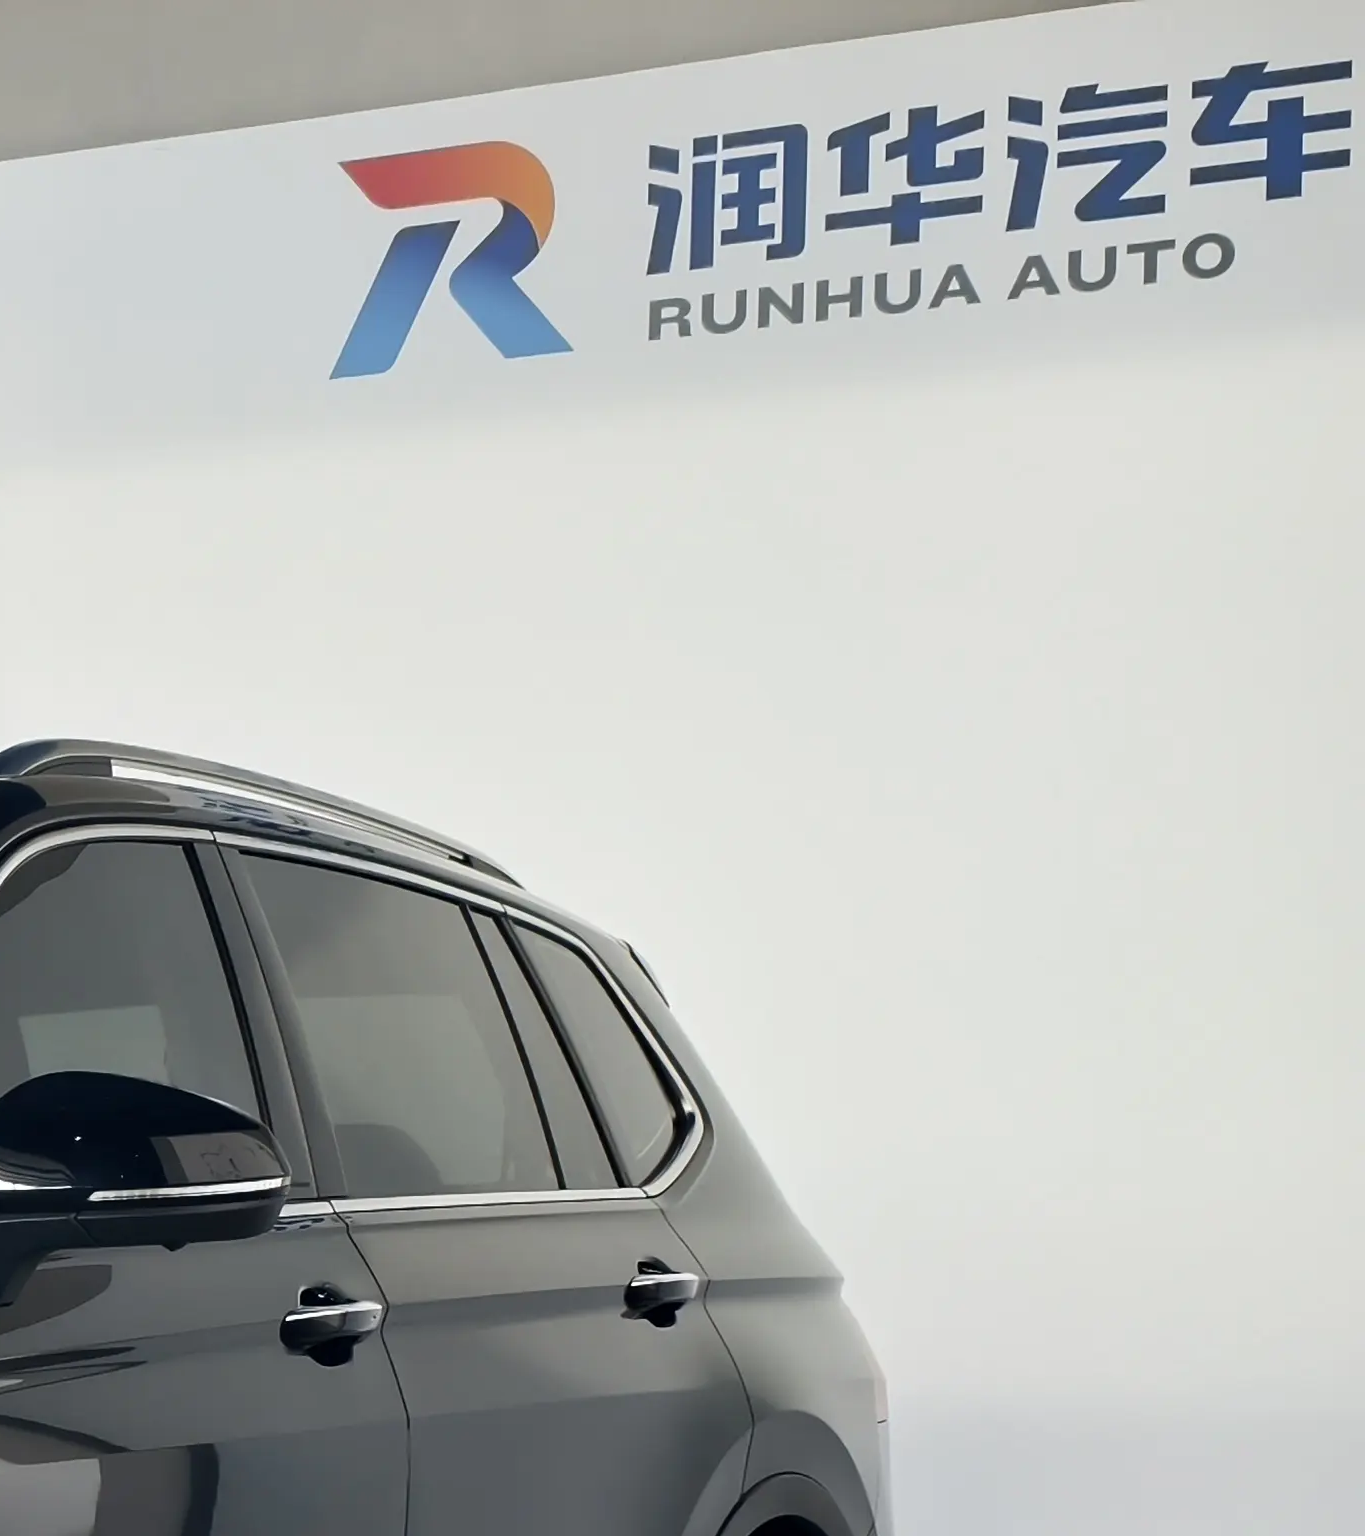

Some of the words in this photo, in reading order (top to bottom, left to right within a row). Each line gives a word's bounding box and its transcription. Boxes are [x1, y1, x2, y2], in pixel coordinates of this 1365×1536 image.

[645, 59, 1353, 276] 润华汽车
[647, 263, 981, 341] RUNHUA
[1007, 232, 1236, 300] AUTO
